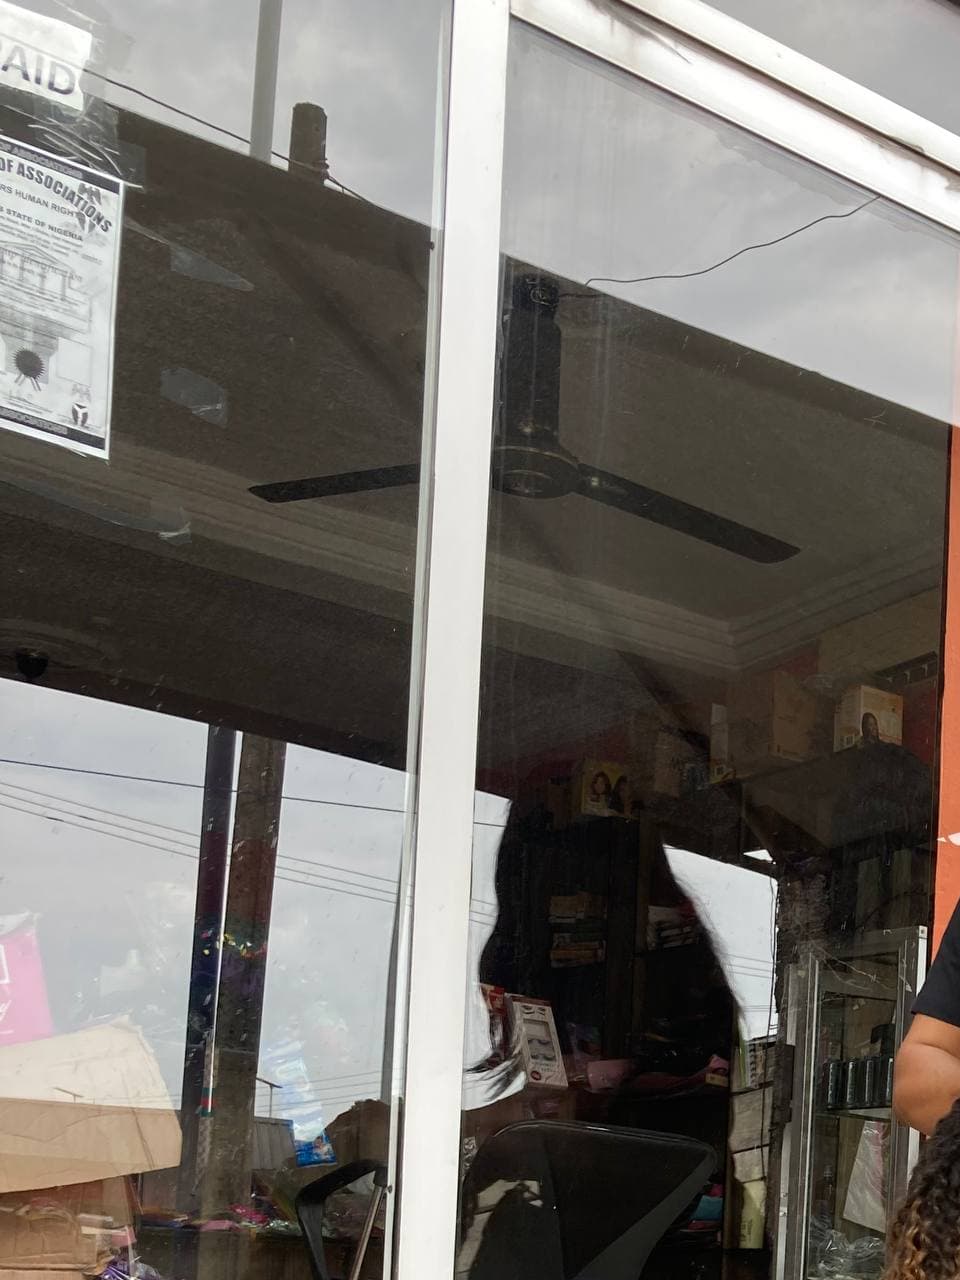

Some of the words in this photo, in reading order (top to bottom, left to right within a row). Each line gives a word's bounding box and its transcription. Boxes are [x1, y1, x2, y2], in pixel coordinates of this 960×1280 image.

[0, 43, 76, 95] AID
[15, 189, 49, 208] HUMAN
[16, 160, 112, 233] ASSOCIATIONS
[47, 223, 83, 241] NIGERIA
